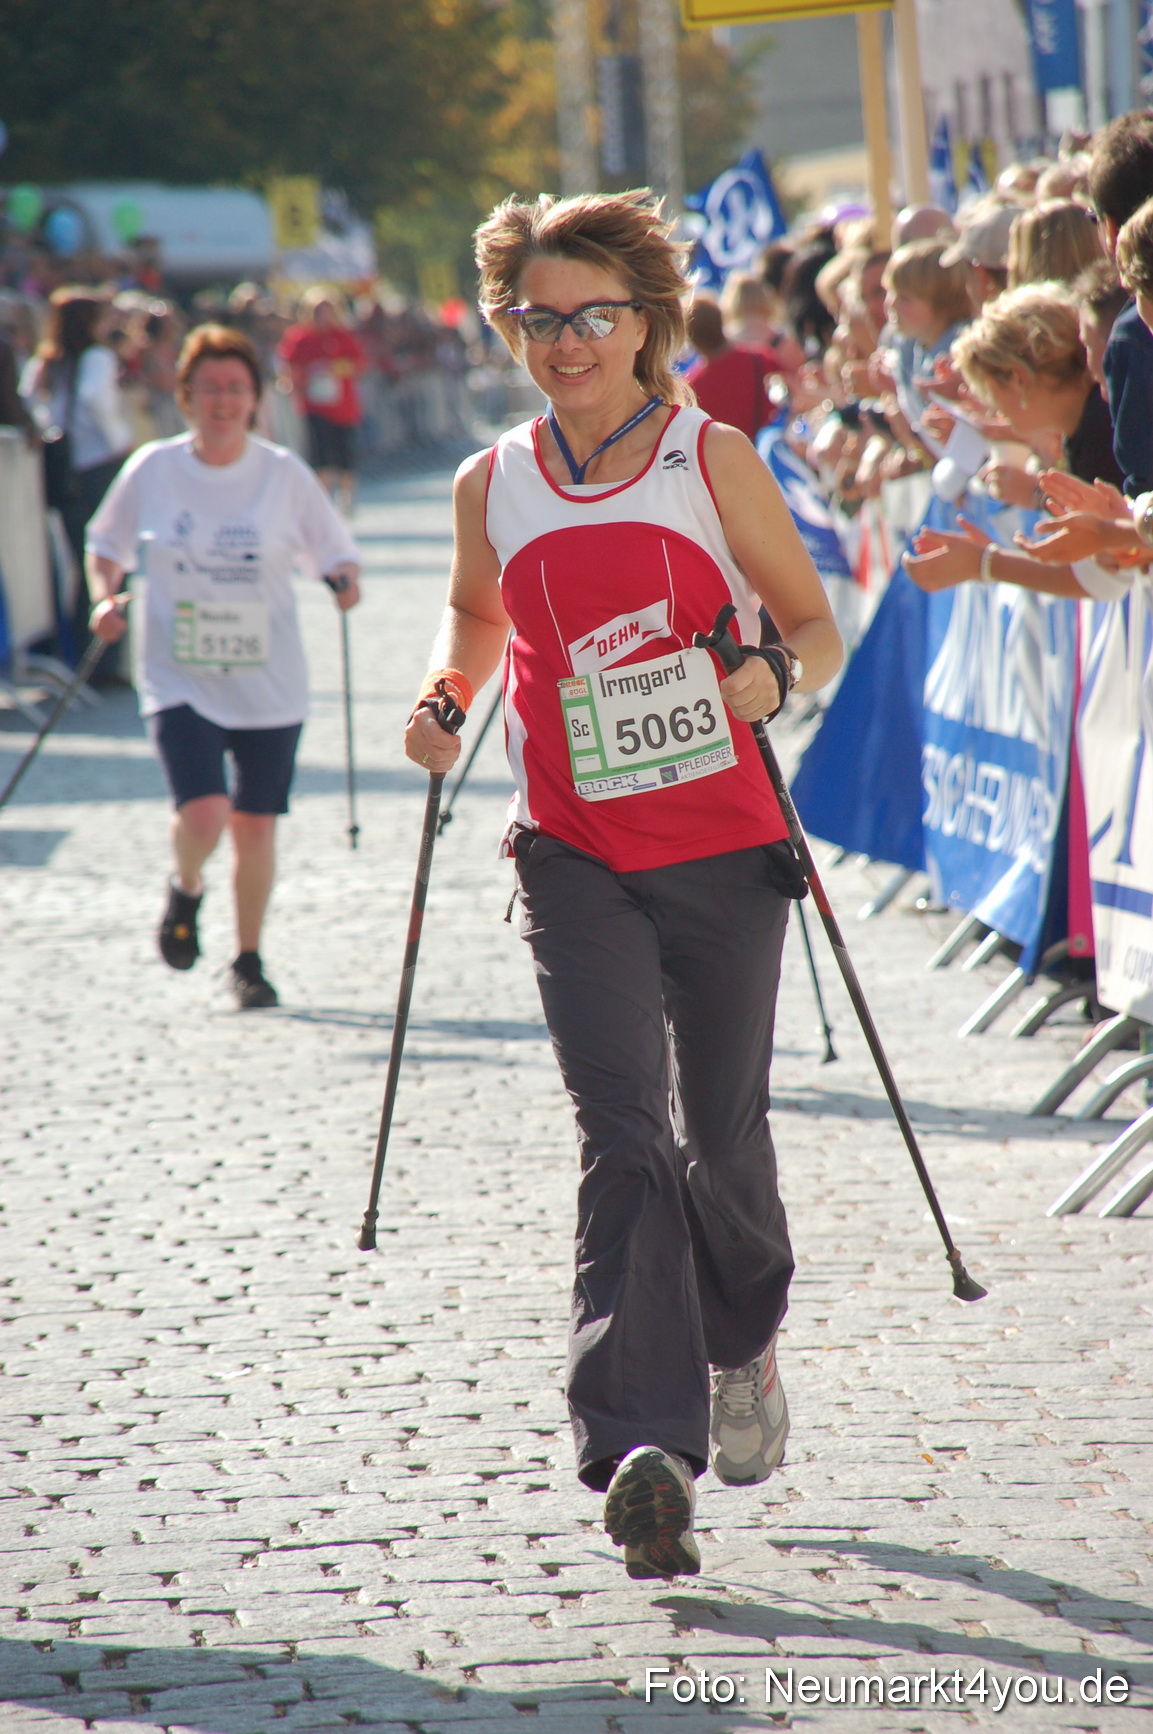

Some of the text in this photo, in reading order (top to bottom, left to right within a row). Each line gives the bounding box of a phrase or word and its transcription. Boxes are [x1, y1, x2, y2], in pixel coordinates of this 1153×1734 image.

[596, 621, 639, 658] DEHN
[598, 655, 687, 698] Irmgard
[571, 718, 590, 738] Sc
[616, 698, 717, 756] 5063
[678, 746, 733, 774] PFLEIDERER
[578, 773, 639, 796] BOCK
